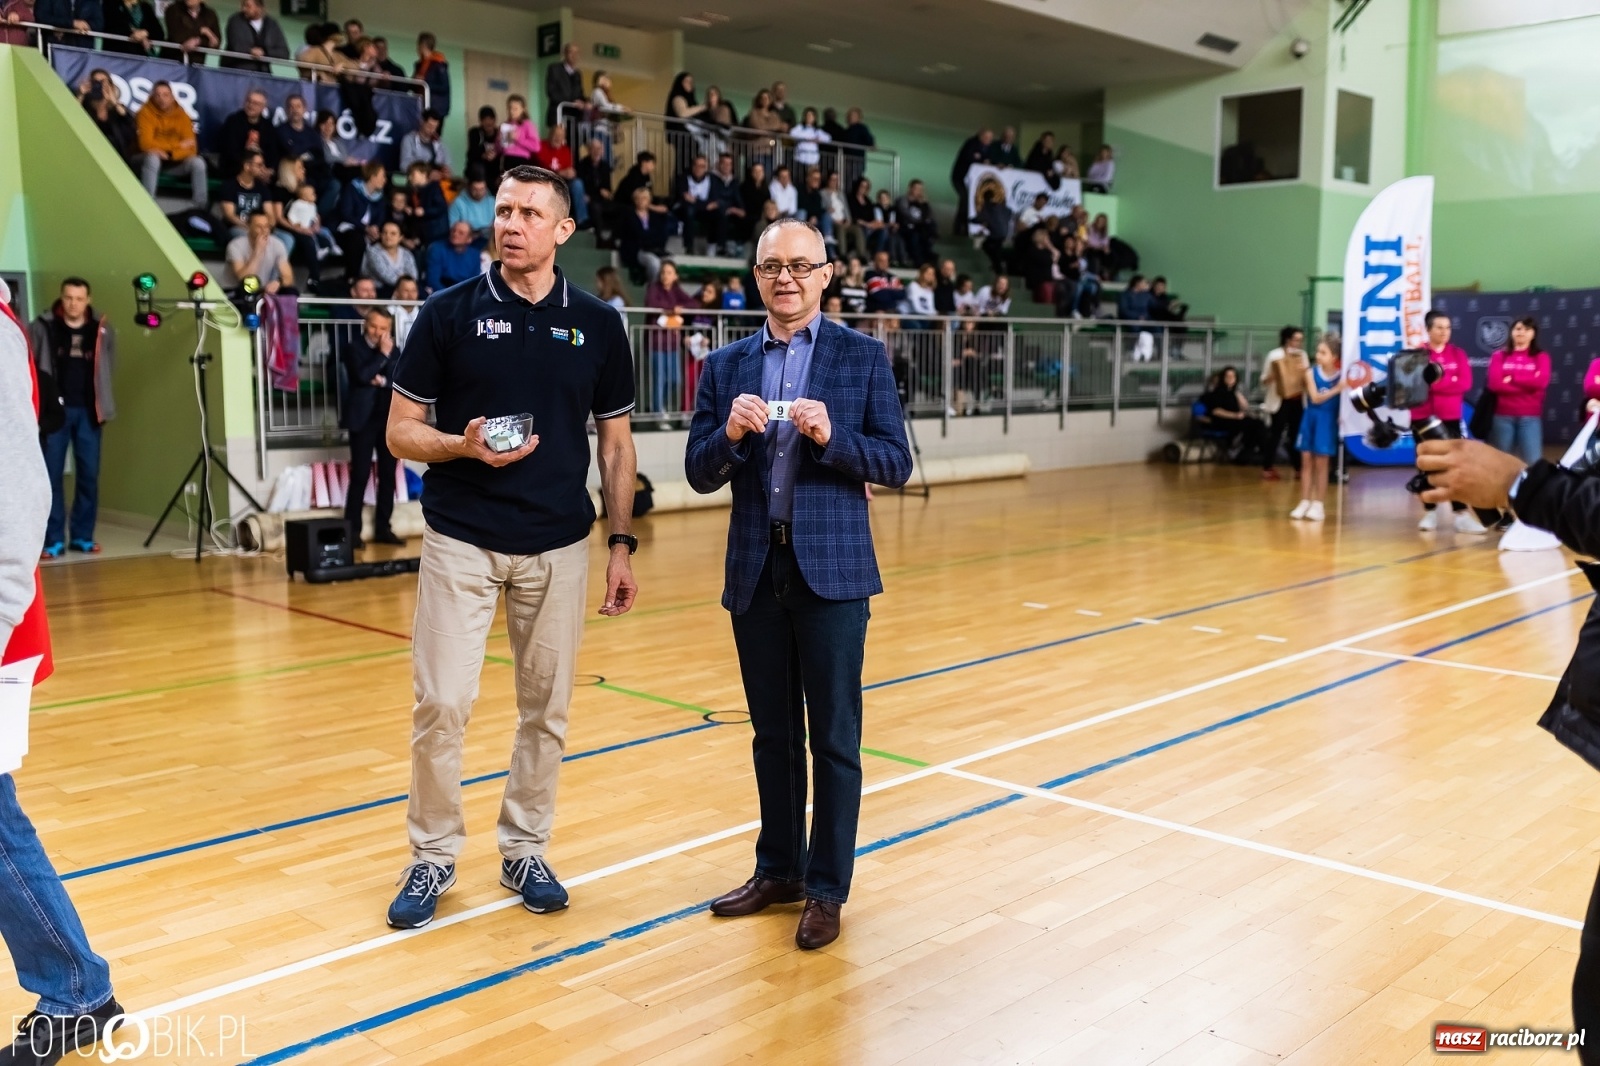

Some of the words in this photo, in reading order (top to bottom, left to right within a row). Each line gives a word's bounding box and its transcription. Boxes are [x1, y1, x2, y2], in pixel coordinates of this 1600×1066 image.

[543, 34, 556, 53] F
[494, 320, 512, 334] nba
[777, 406, 784, 415] 9
